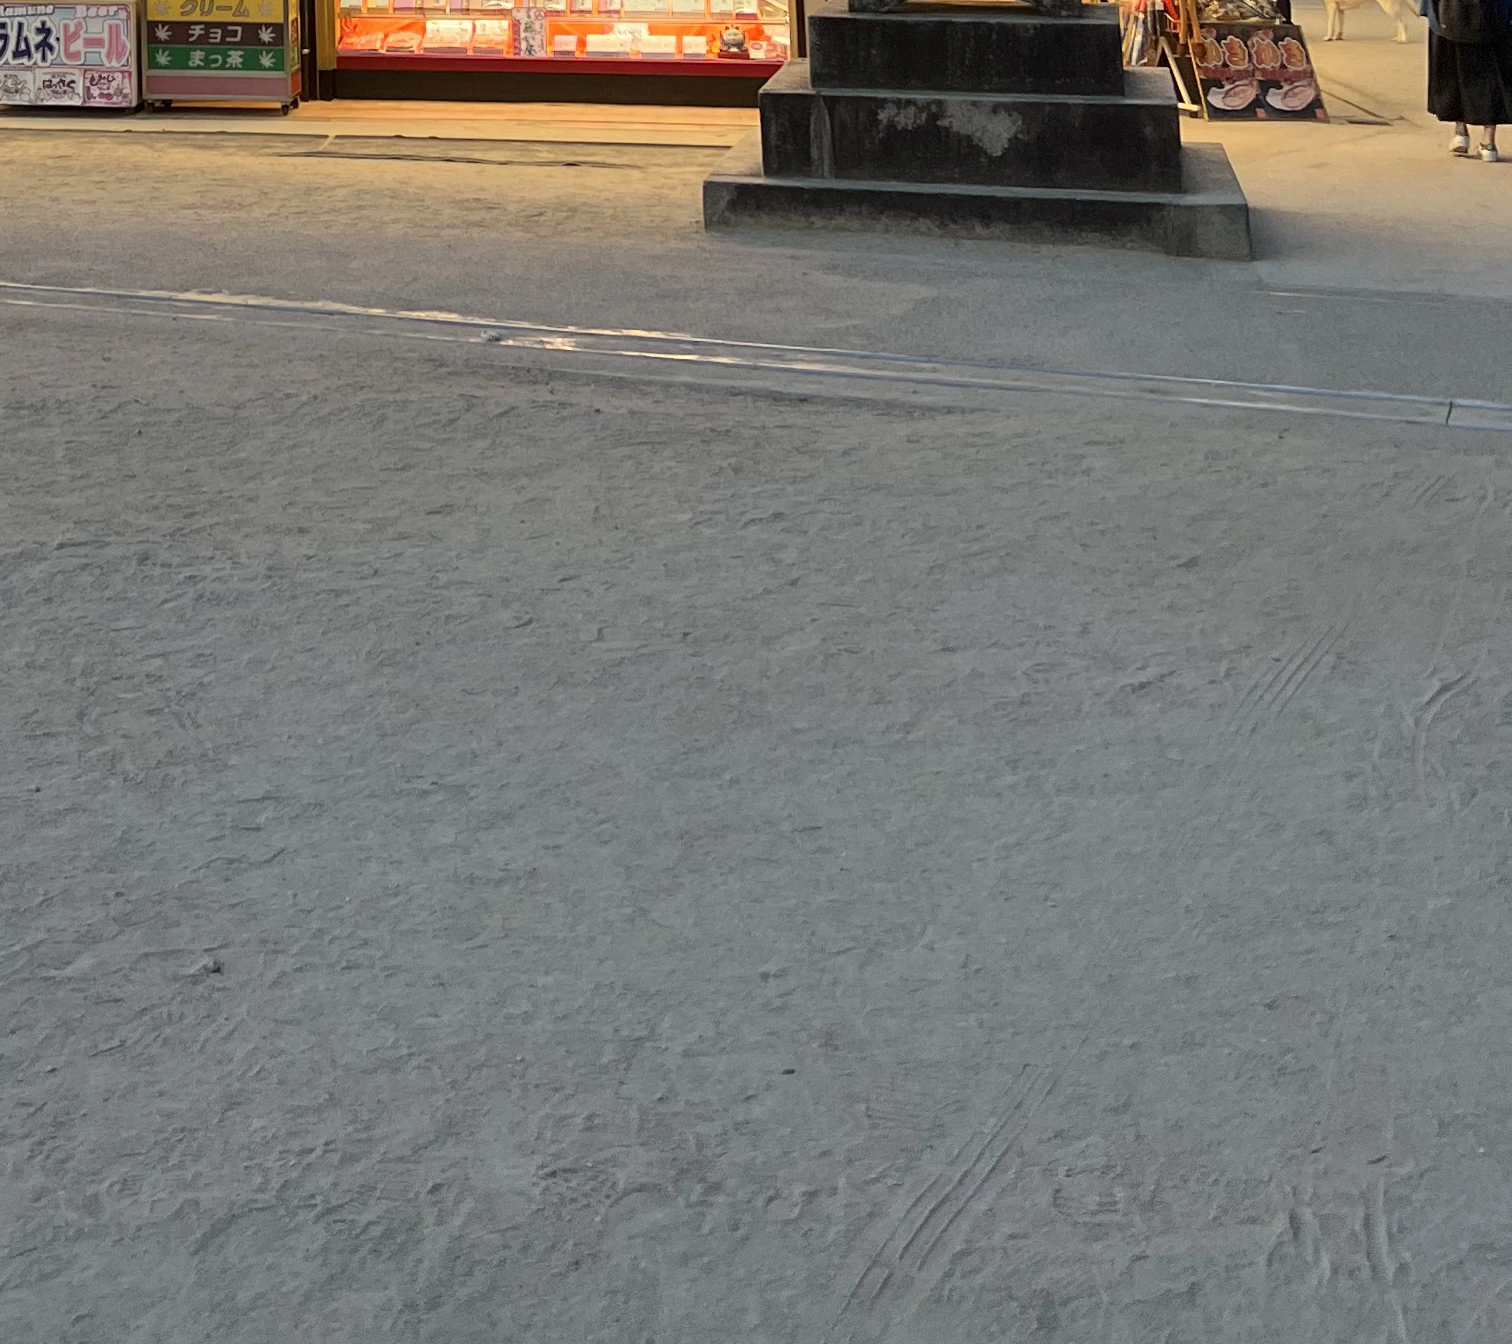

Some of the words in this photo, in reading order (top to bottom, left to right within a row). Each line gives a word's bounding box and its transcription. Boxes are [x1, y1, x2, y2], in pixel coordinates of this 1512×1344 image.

[188, 24, 243, 43] チョコ
[188, 50, 245, 69] まっ茶
